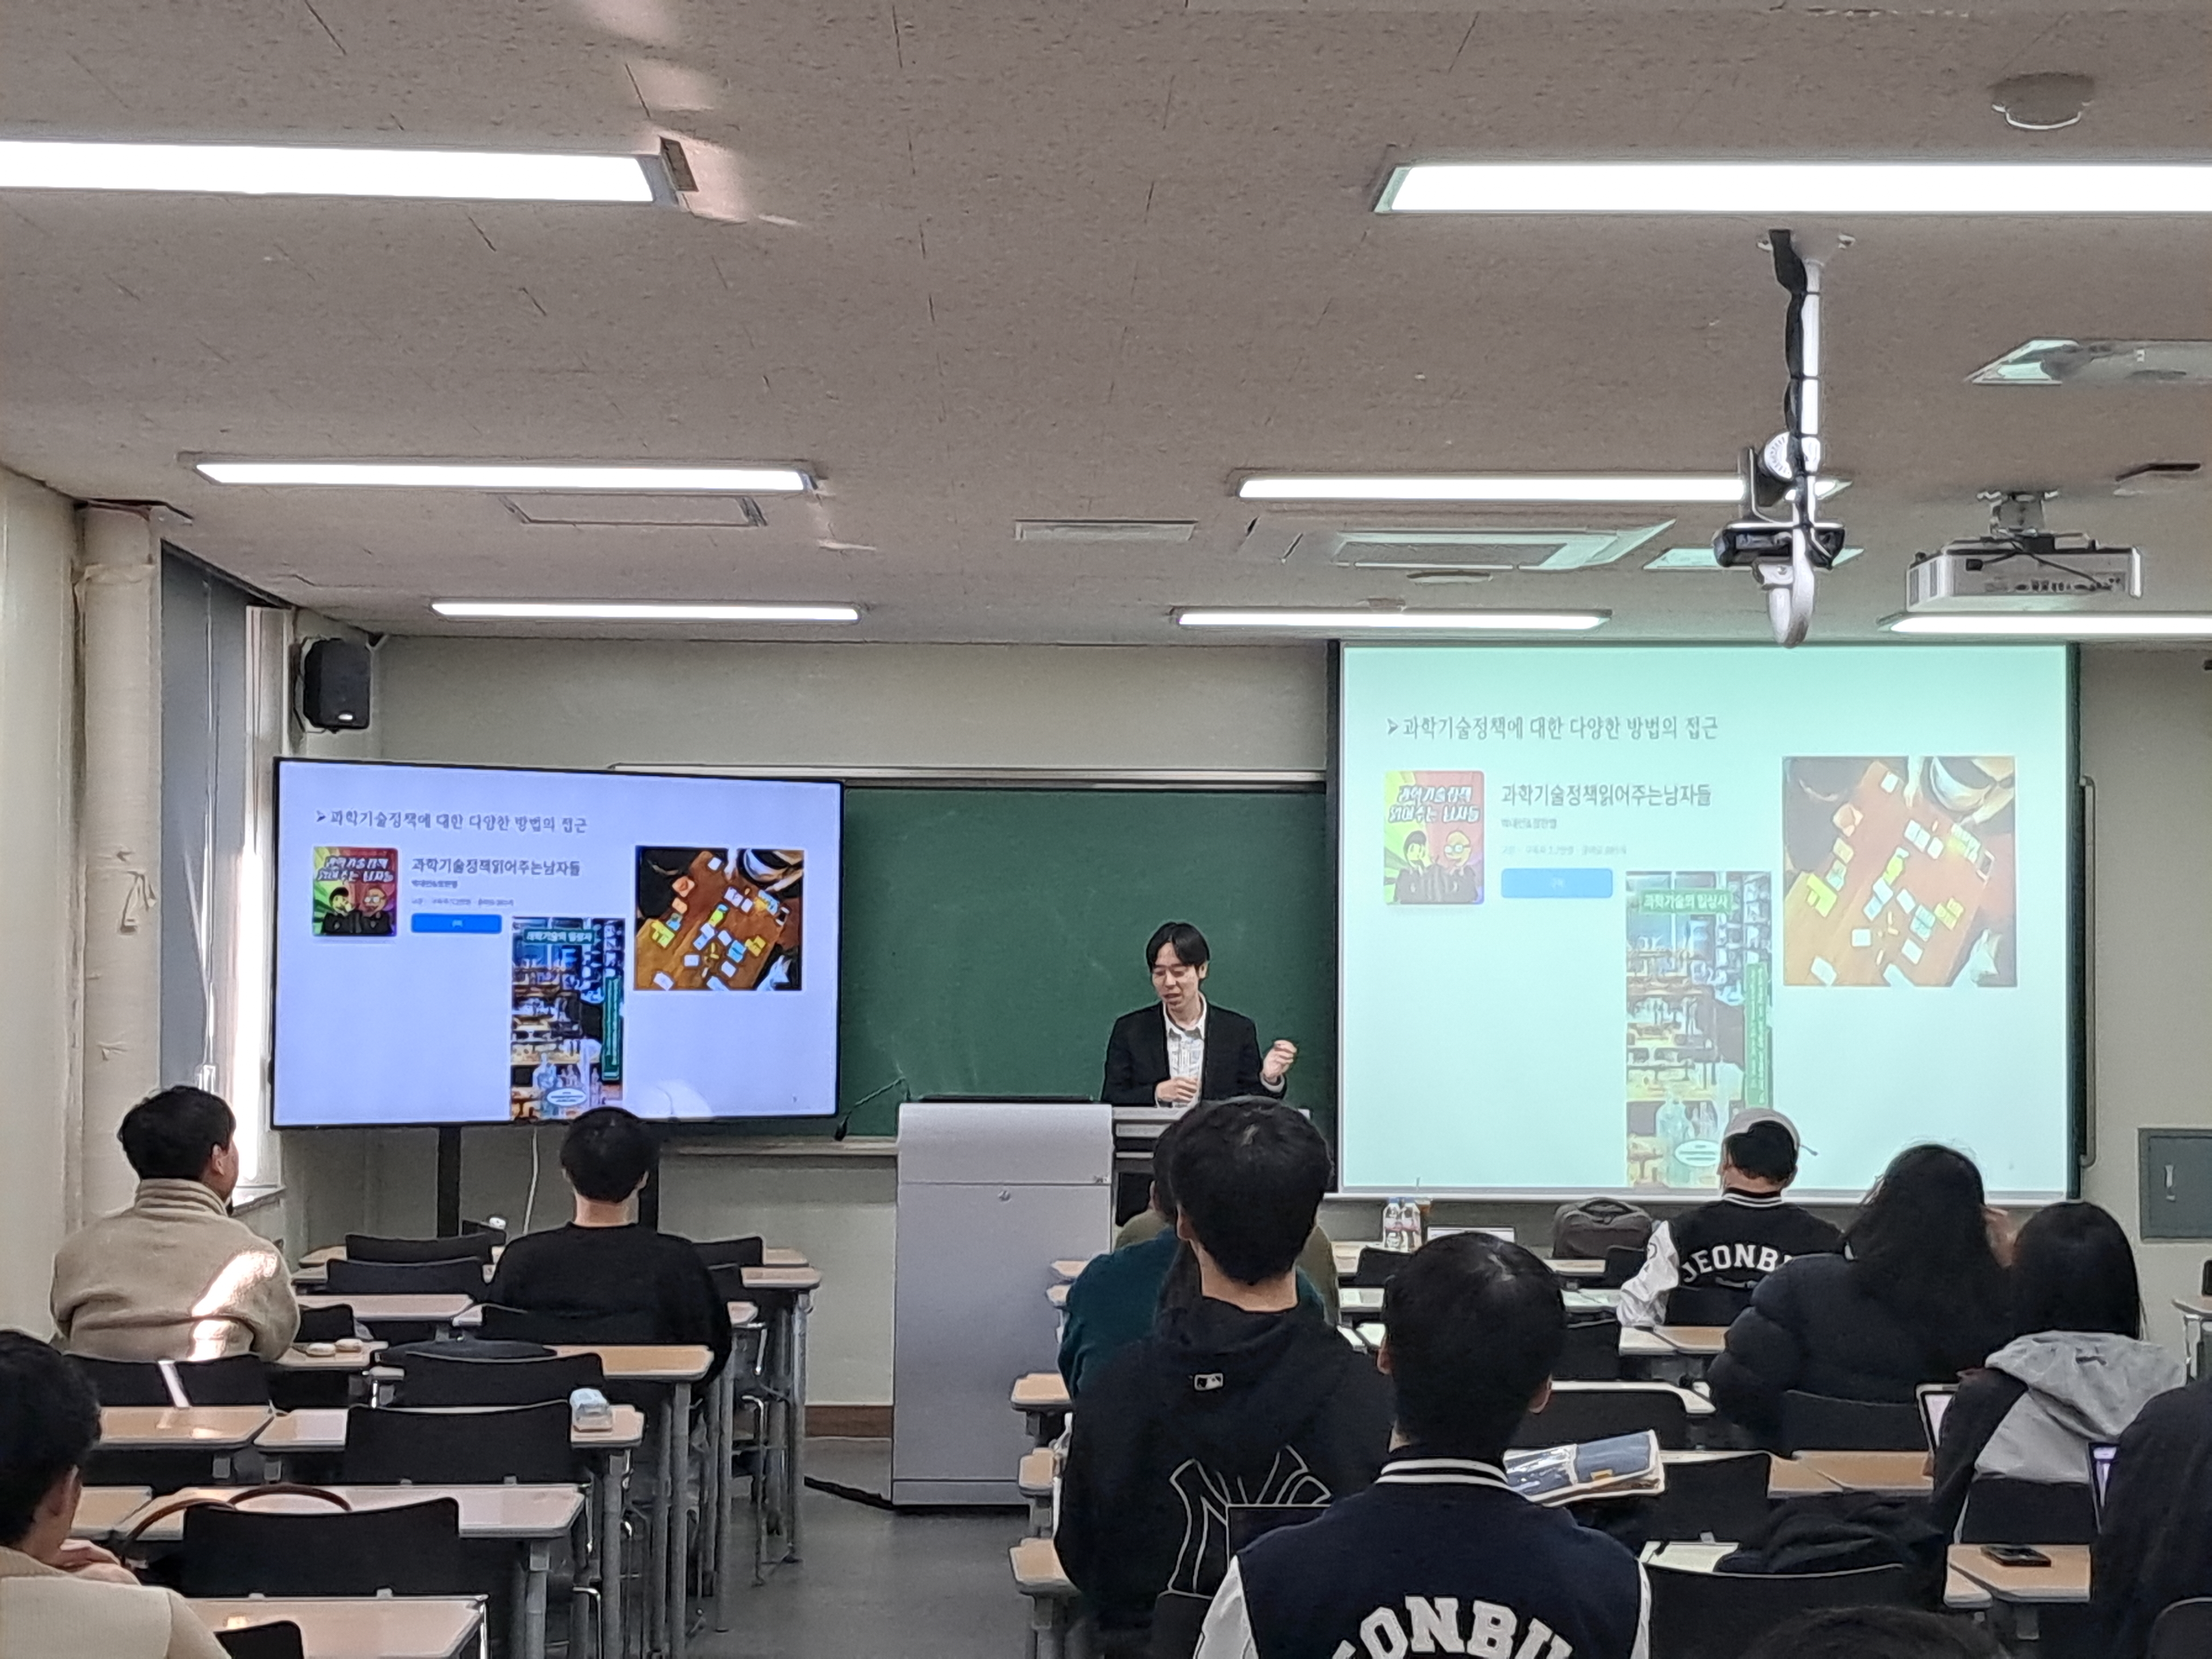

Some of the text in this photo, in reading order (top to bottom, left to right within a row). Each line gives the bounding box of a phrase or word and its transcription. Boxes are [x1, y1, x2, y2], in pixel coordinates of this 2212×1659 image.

[1403, 716, 1718, 740] 과학기술정책에 대한 다양한 방법의 접근
[1501, 783, 1711, 807] 과학기술정책읽어주는남자들
[331, 810, 588, 833] 과학기술정책에 대한 다양한 방법의 접근
[411, 858, 580, 877] 과학기술정책읽어주는남자들
